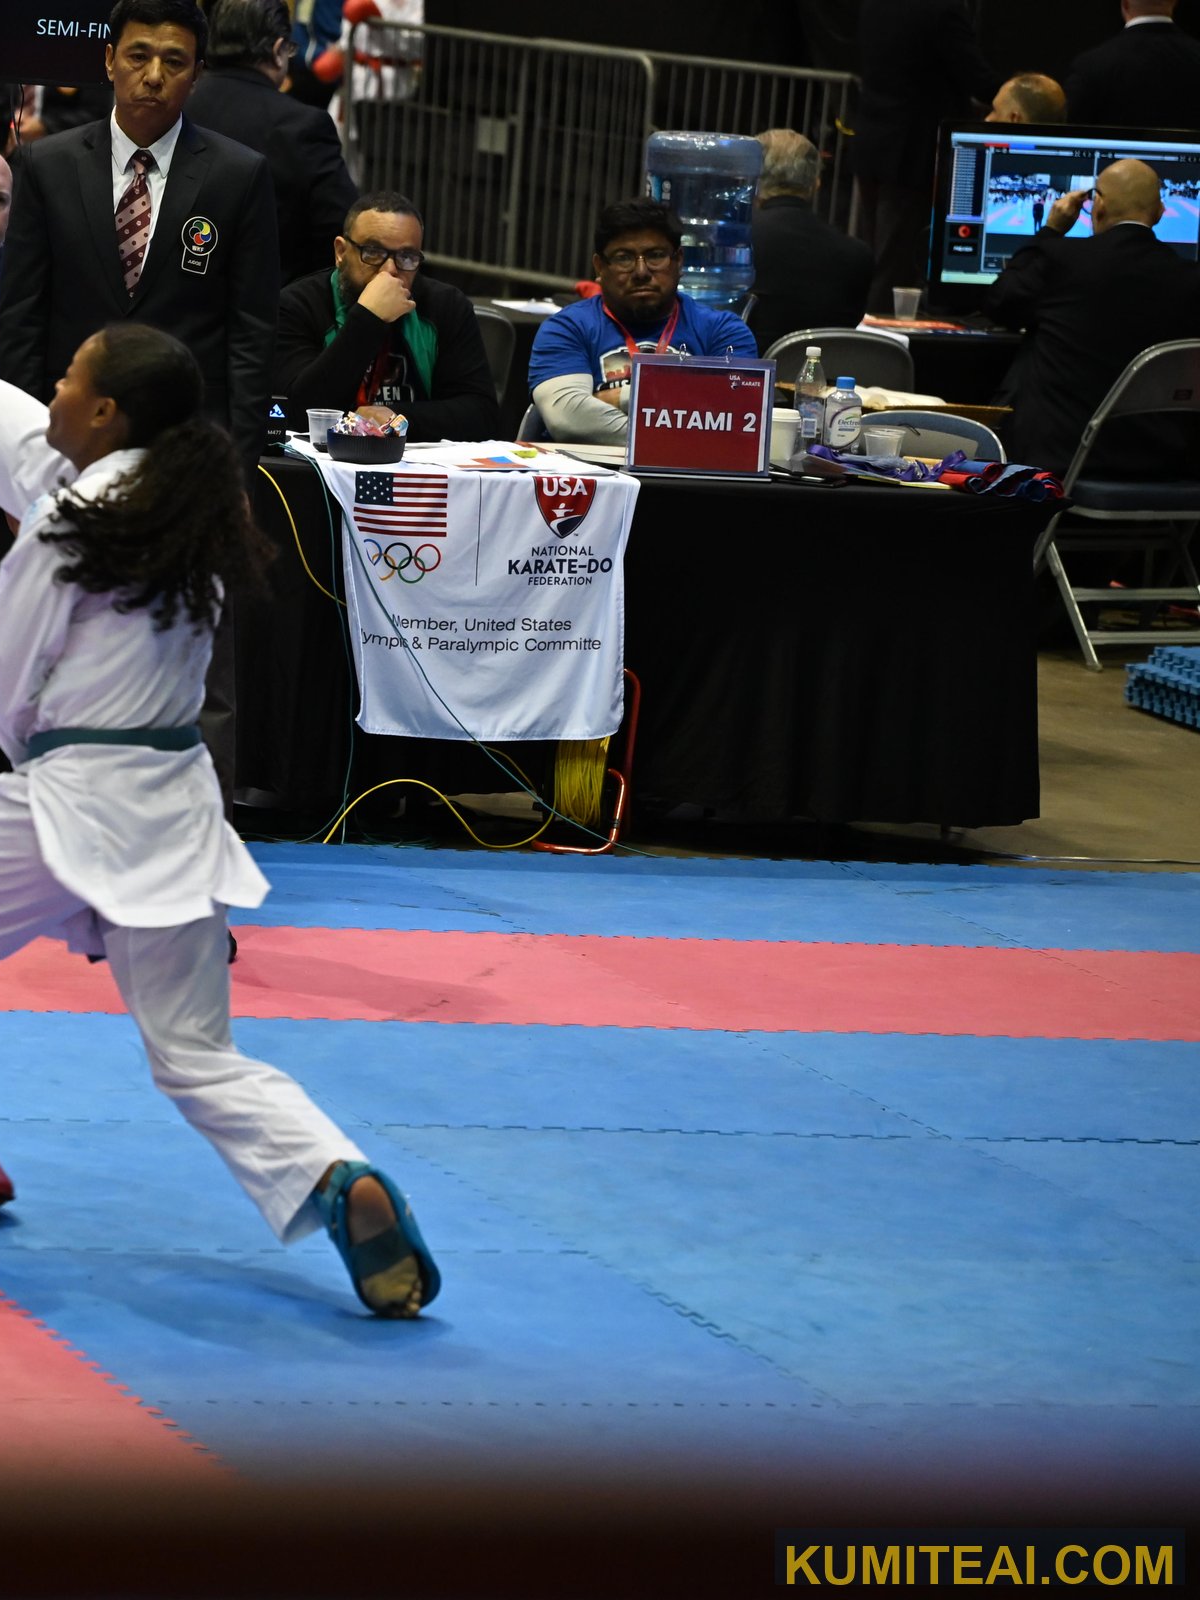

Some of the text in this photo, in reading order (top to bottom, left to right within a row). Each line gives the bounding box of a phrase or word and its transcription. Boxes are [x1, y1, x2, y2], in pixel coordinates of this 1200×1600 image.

[642, 408, 756, 433] TATAMI 2
[542, 477, 588, 497] USA
[531, 545, 595, 557] NATIONAL
[508, 557, 613, 575] KARATE-DO
[527, 576, 593, 586] FEDERATION
[464, 618, 516, 632] United
[521, 617, 572, 632] States
[412, 636, 423, 650] &
[428, 637, 519, 654] Paralympic
